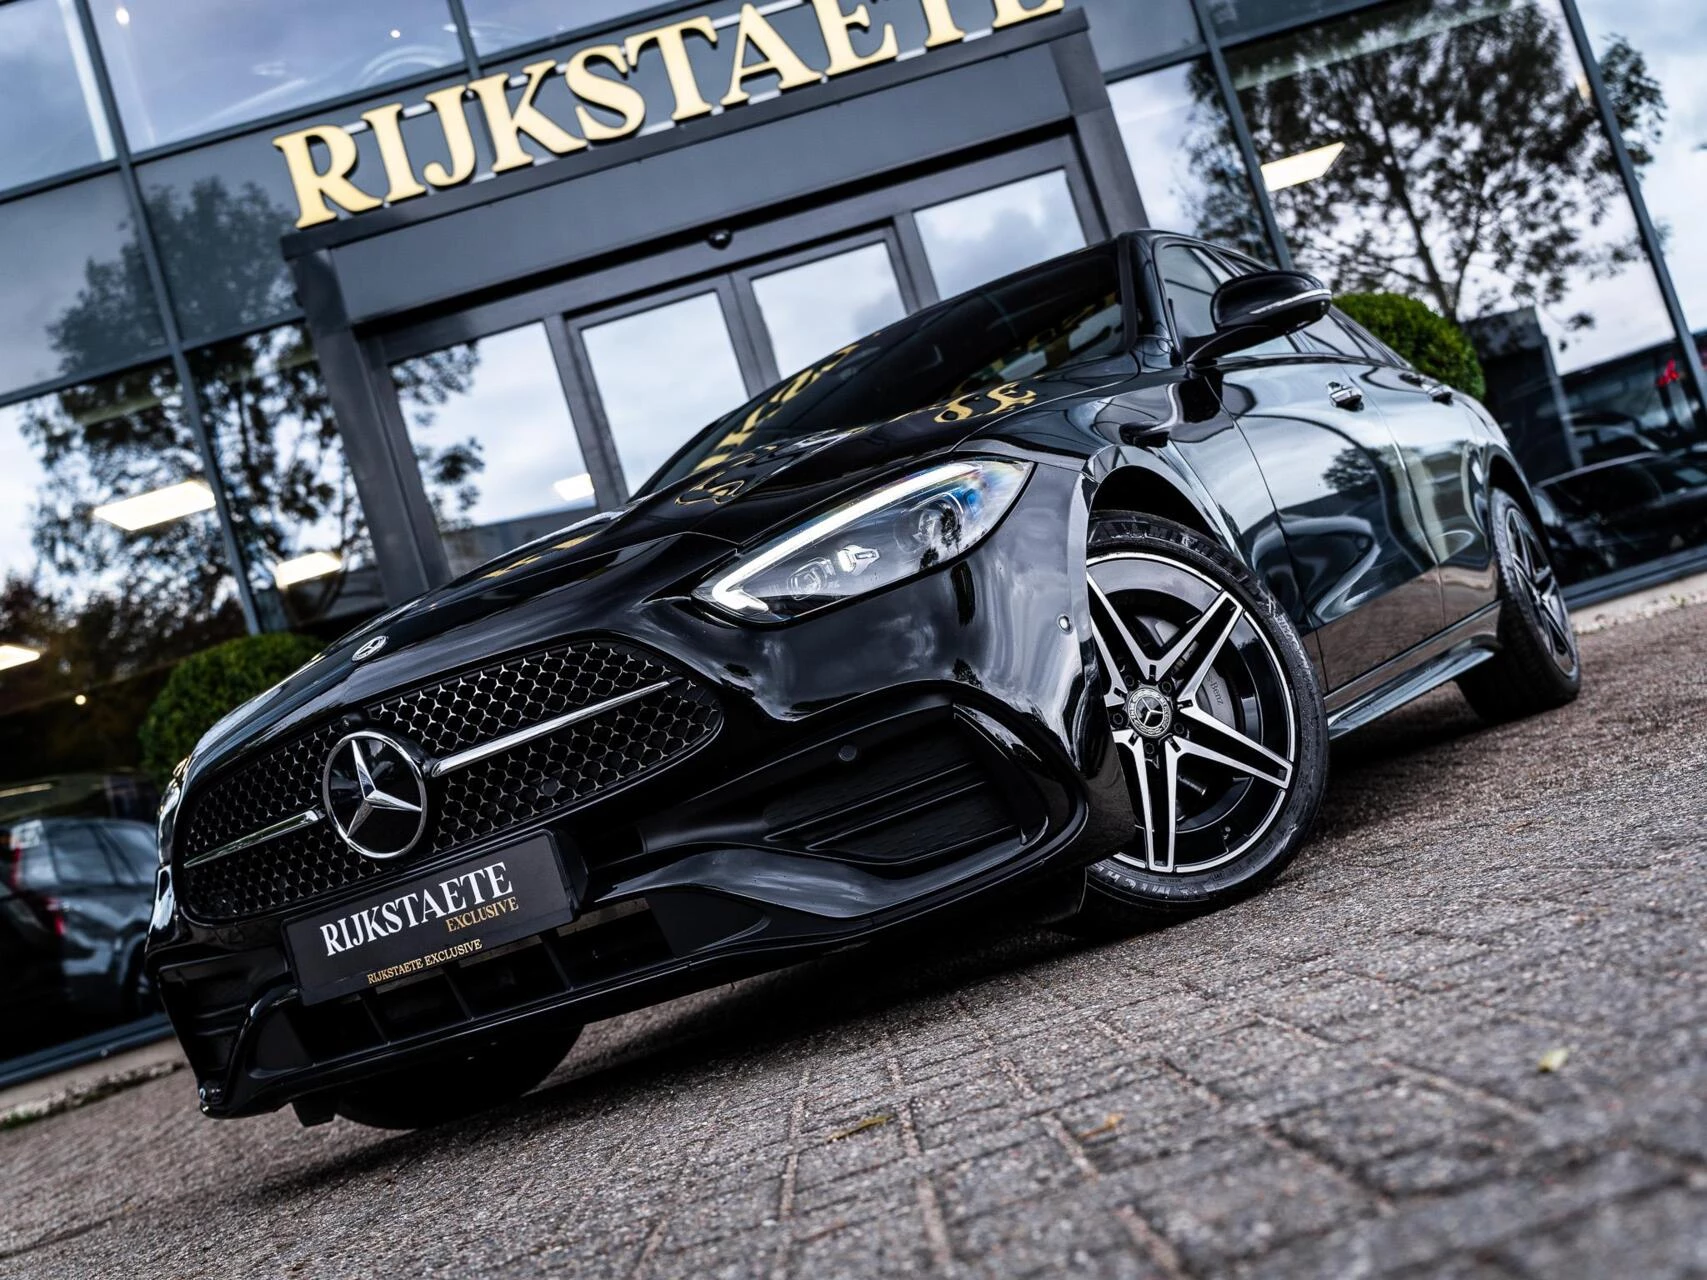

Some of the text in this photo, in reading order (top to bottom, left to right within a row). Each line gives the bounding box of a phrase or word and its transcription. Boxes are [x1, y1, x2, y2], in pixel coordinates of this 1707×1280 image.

[272, 0, 1064, 229] RIJKSTAE
[320, 861, 513, 957] RIJKSTAETE
[445, 896, 519, 933] EXCLUSIVE
[367, 938, 483, 984] RIJKSTAETE EXCLUSIVE
